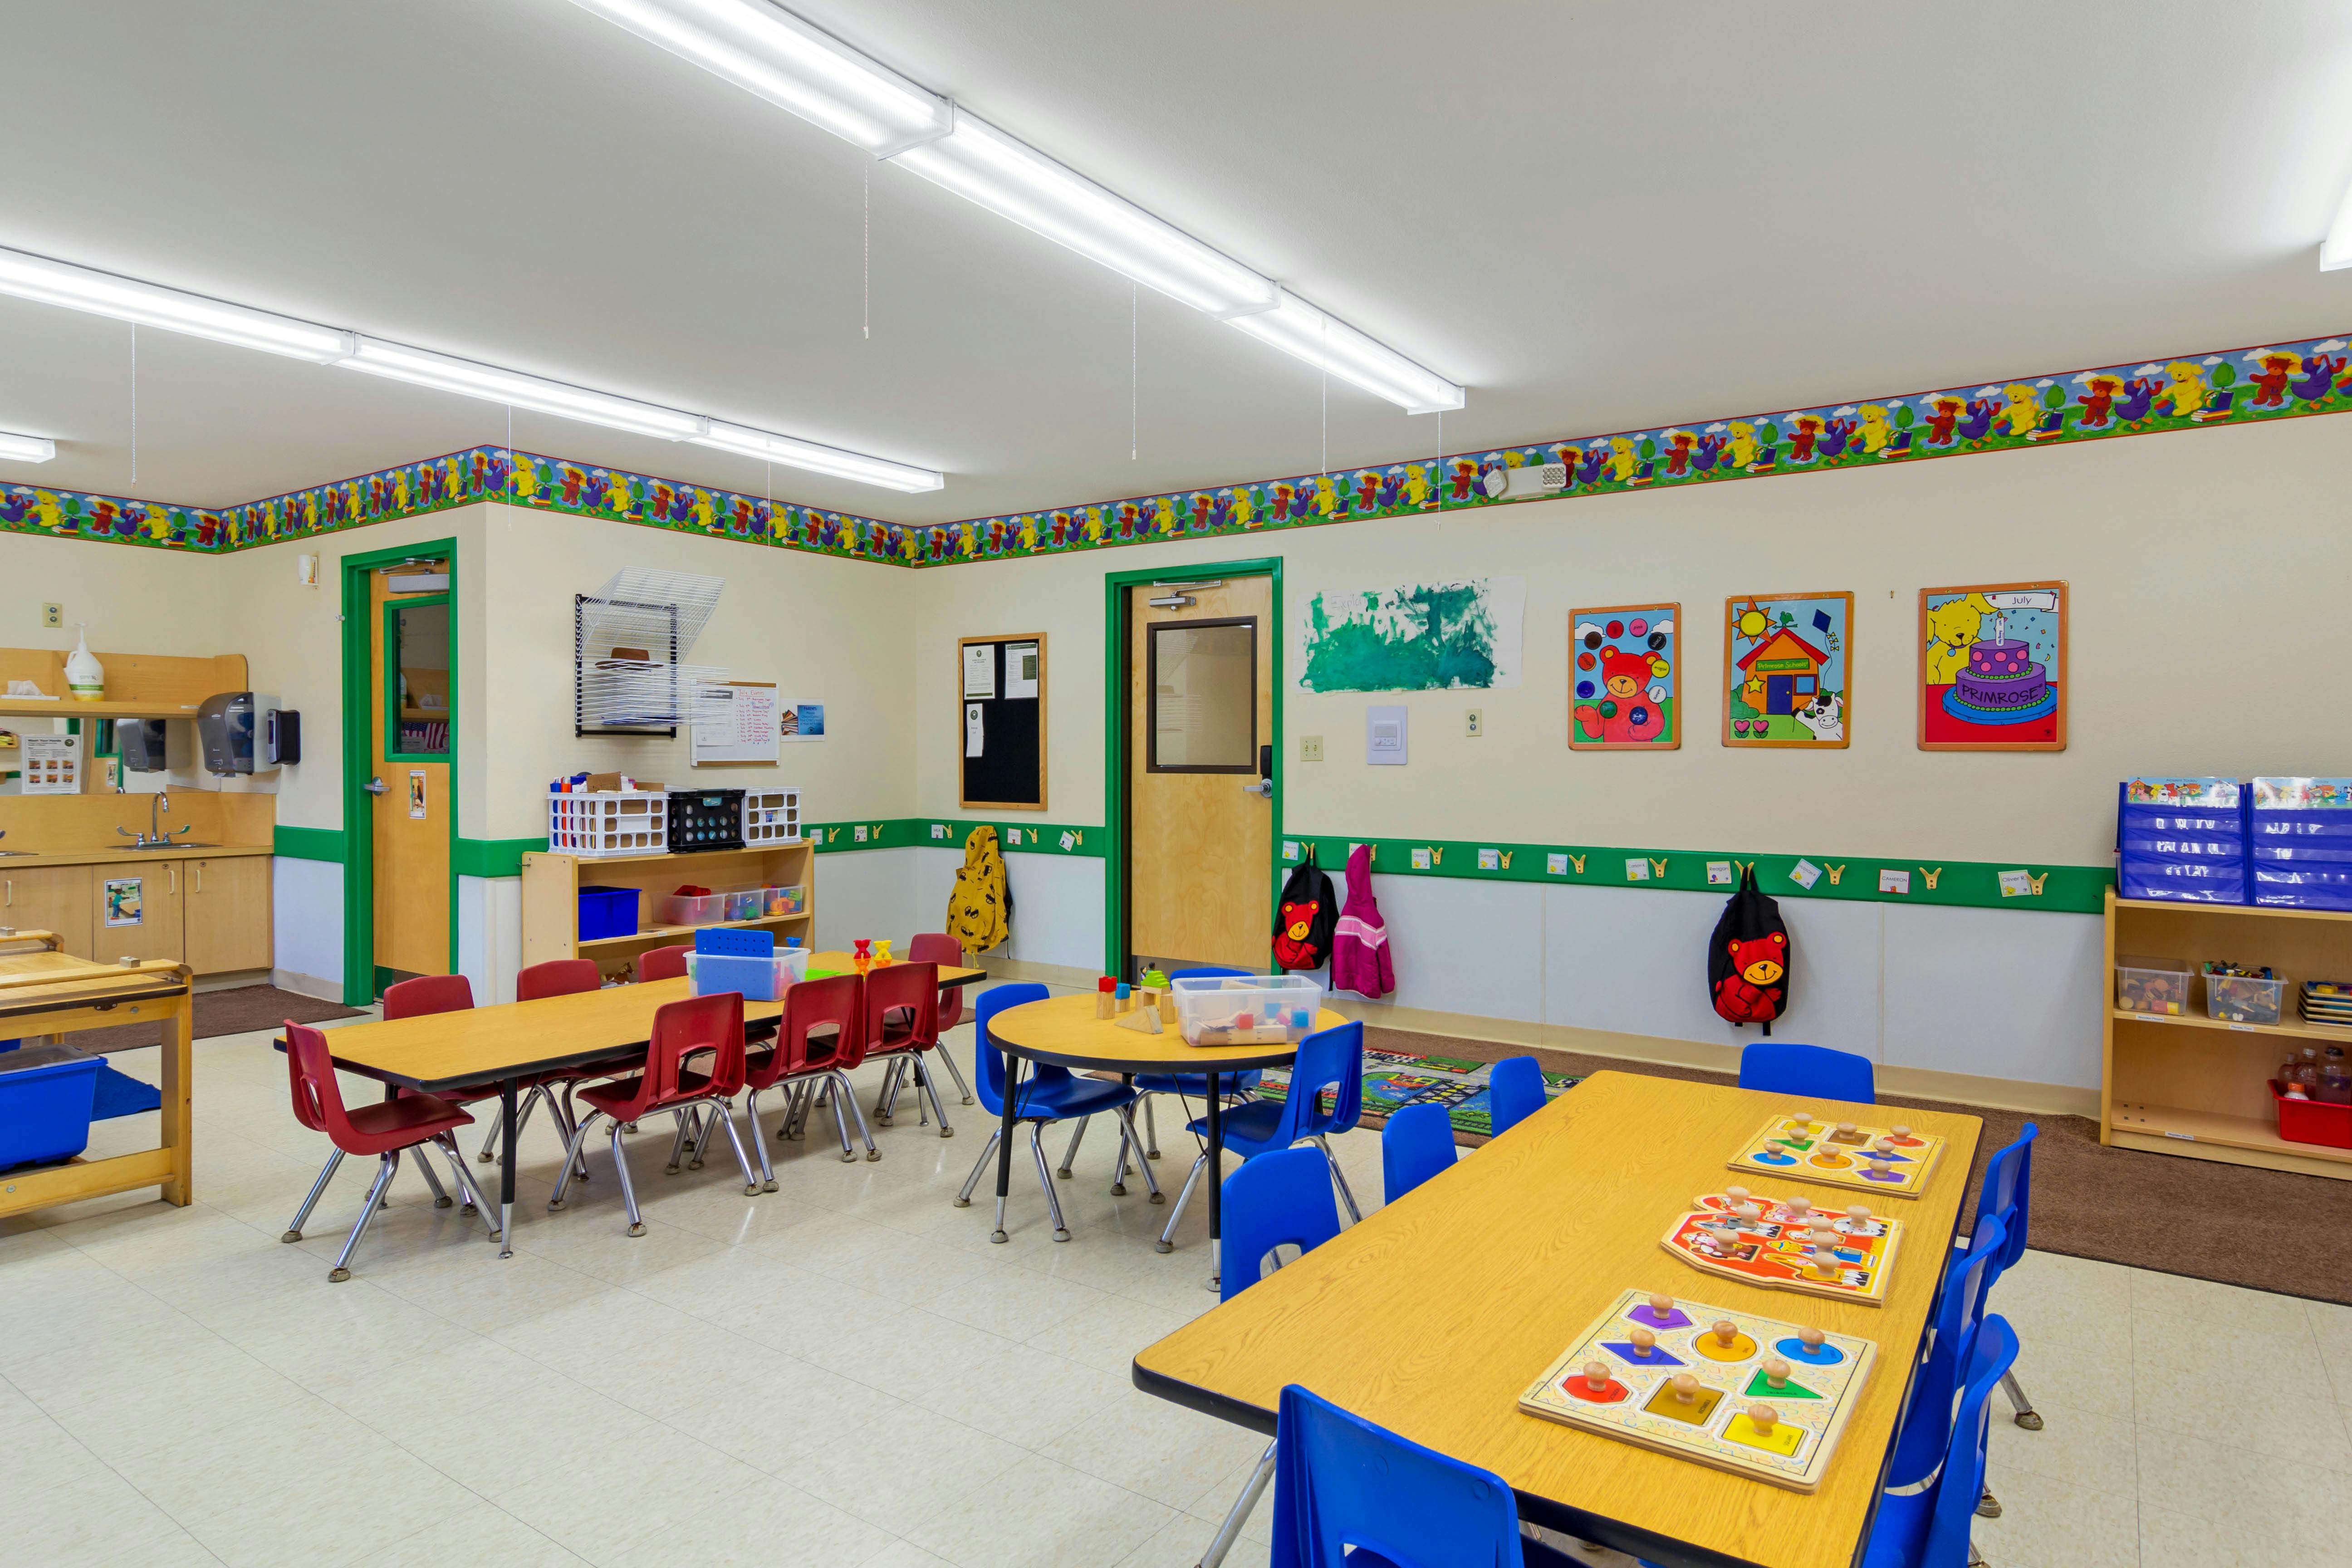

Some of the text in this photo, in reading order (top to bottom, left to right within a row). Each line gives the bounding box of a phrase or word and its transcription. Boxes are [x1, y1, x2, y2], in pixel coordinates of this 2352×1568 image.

[2012, 596, 2032, 605] July
[1652, 636, 1662, 648] black
[1962, 683, 2040, 705] PRIMROSE
